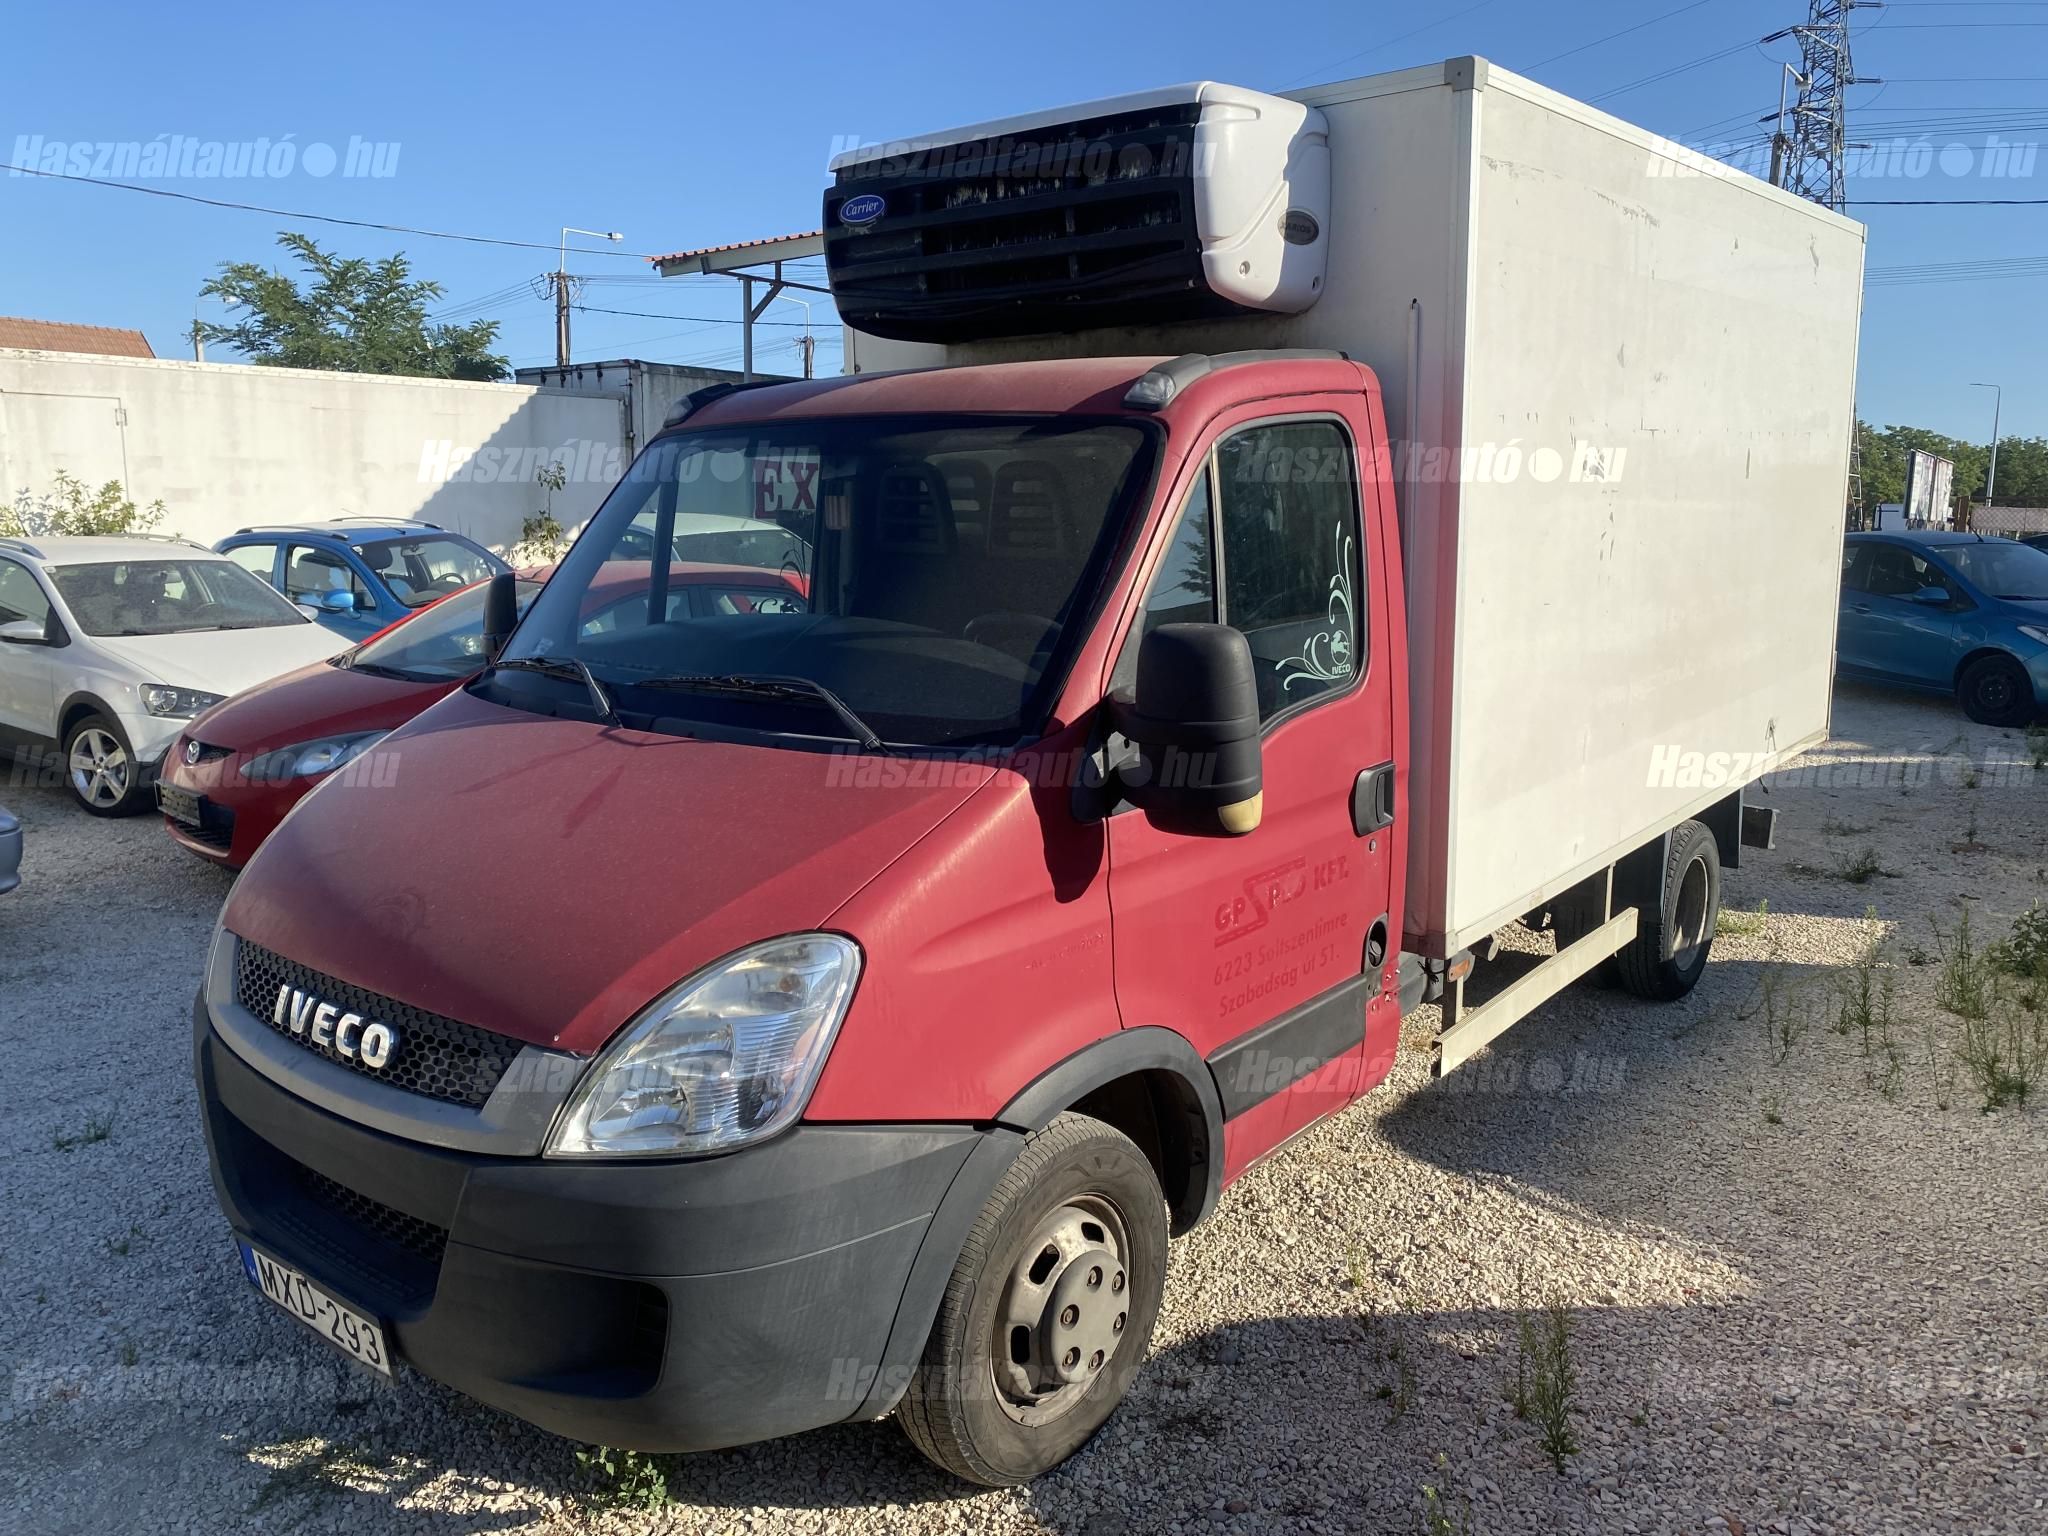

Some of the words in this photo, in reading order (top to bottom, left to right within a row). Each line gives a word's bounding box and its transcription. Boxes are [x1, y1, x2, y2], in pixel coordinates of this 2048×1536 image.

[845, 200, 879, 217] Carrier
[1331, 663, 1351, 675] IVECO
[1313, 855, 1350, 891] KFT.
[1214, 951, 1252, 986] 6223
[1219, 965, 1298, 1018] Szabadság
[273, 983, 394, 1069] IVECO
[257, 1254, 381, 1365] MXD-293
